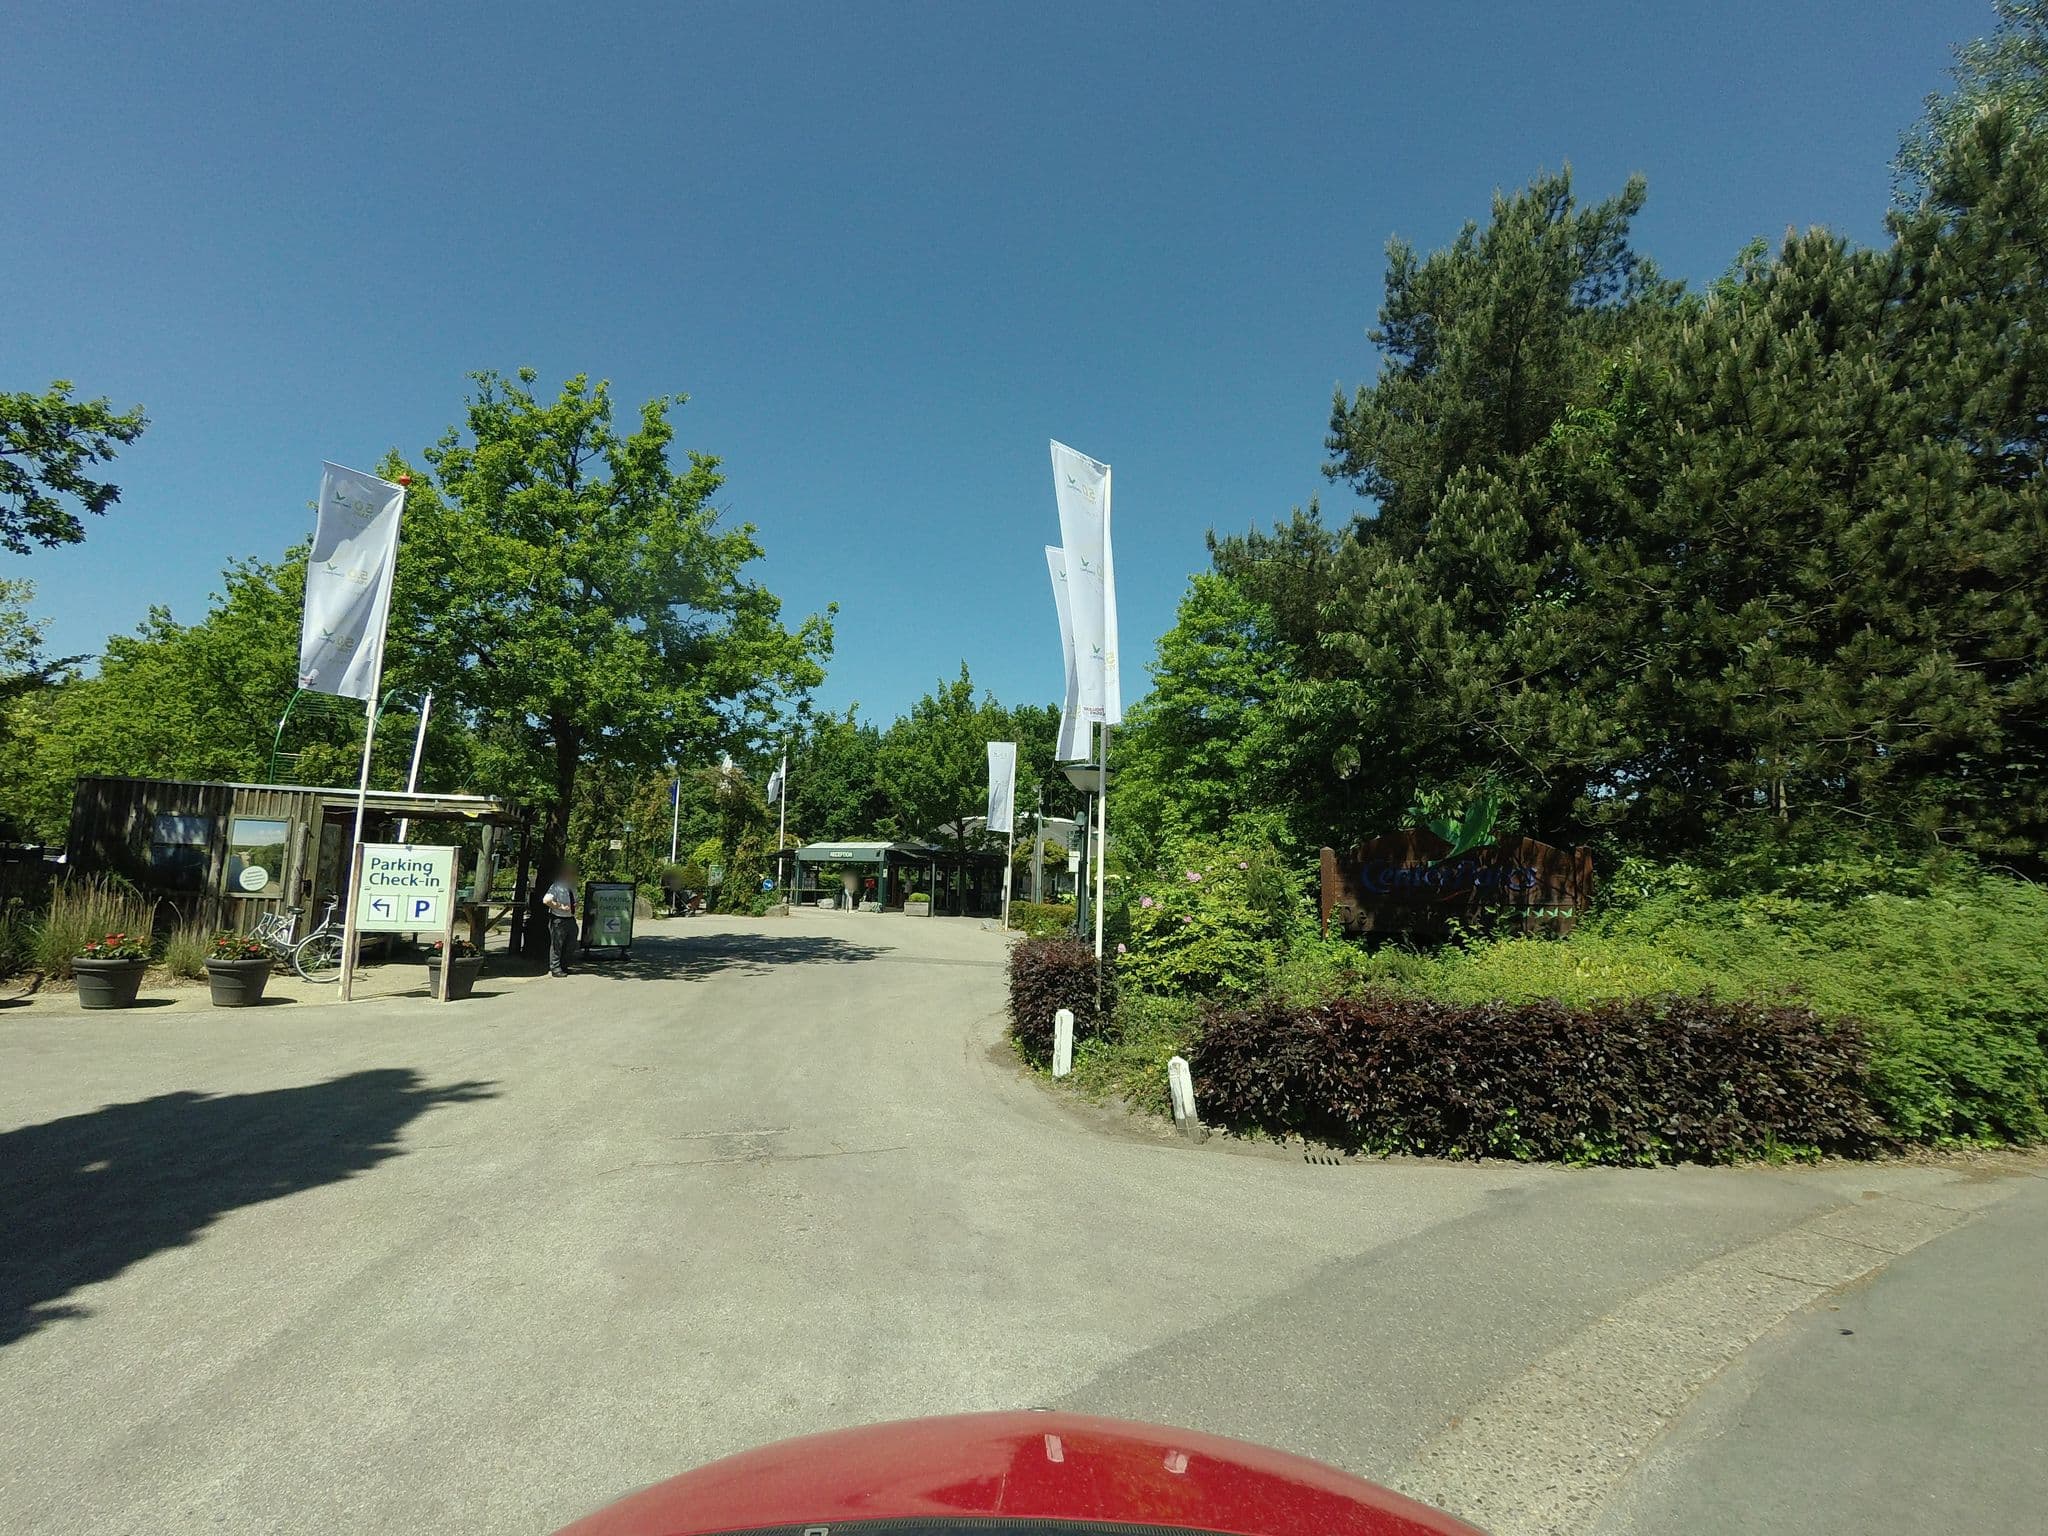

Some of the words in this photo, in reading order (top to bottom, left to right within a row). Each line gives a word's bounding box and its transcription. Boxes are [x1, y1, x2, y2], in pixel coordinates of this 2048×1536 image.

[371, 857, 433, 876] Parking
[369, 872, 440, 887] Check-in
[415, 900, 430, 918] P
